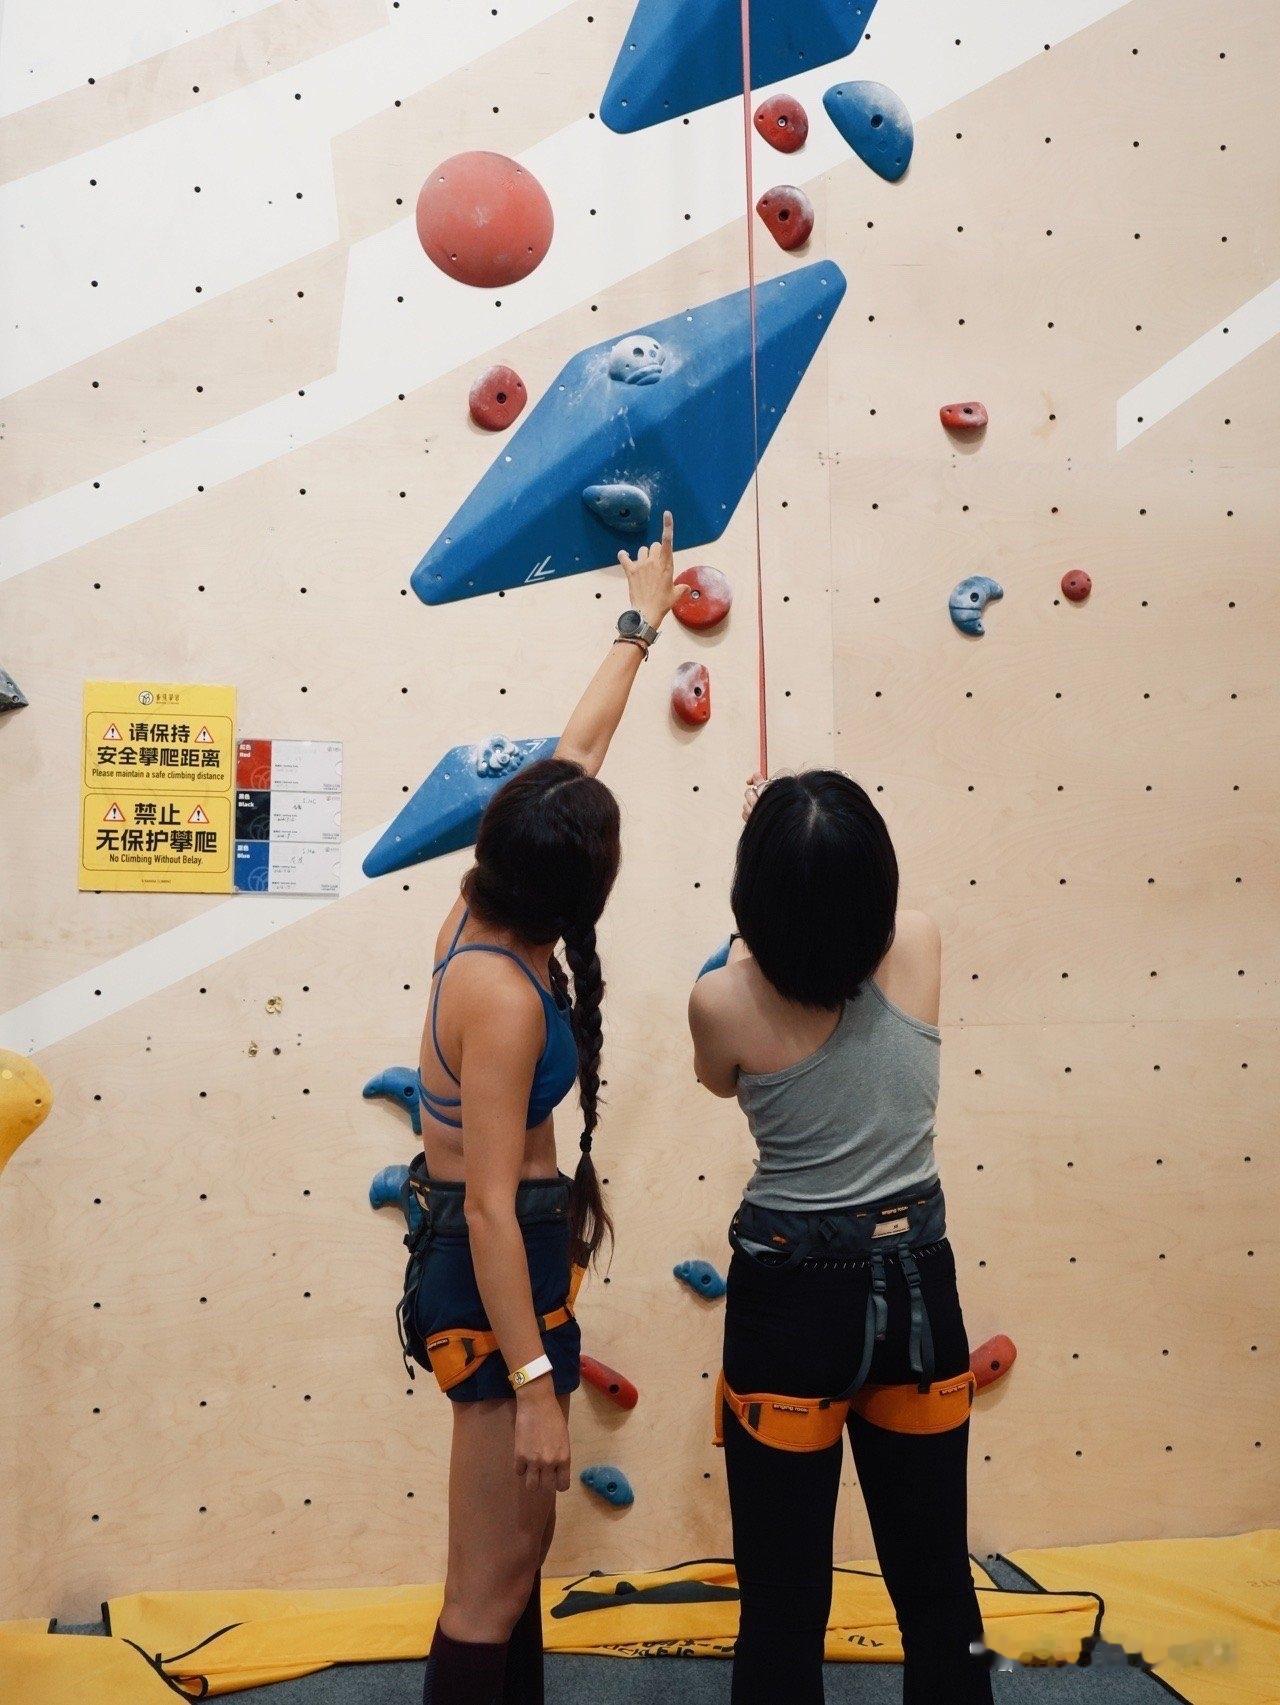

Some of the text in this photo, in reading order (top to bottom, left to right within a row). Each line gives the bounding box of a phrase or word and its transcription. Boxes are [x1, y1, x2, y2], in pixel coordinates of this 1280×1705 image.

[129, 723, 190, 743] 请保持
[97, 747, 221, 768] 安全攀爬距离
[92, 769, 114, 778] Please
[116, 771, 144, 779] maintain
[152, 770, 166, 779] safe
[168, 771, 195, 781] climbing
[197, 771, 224, 780] distance
[134, 803, 181, 826] 禁止
[96, 829, 217, 853] 无保护攀爬
[110, 854, 203, 865] No Climbing Without Belay.
